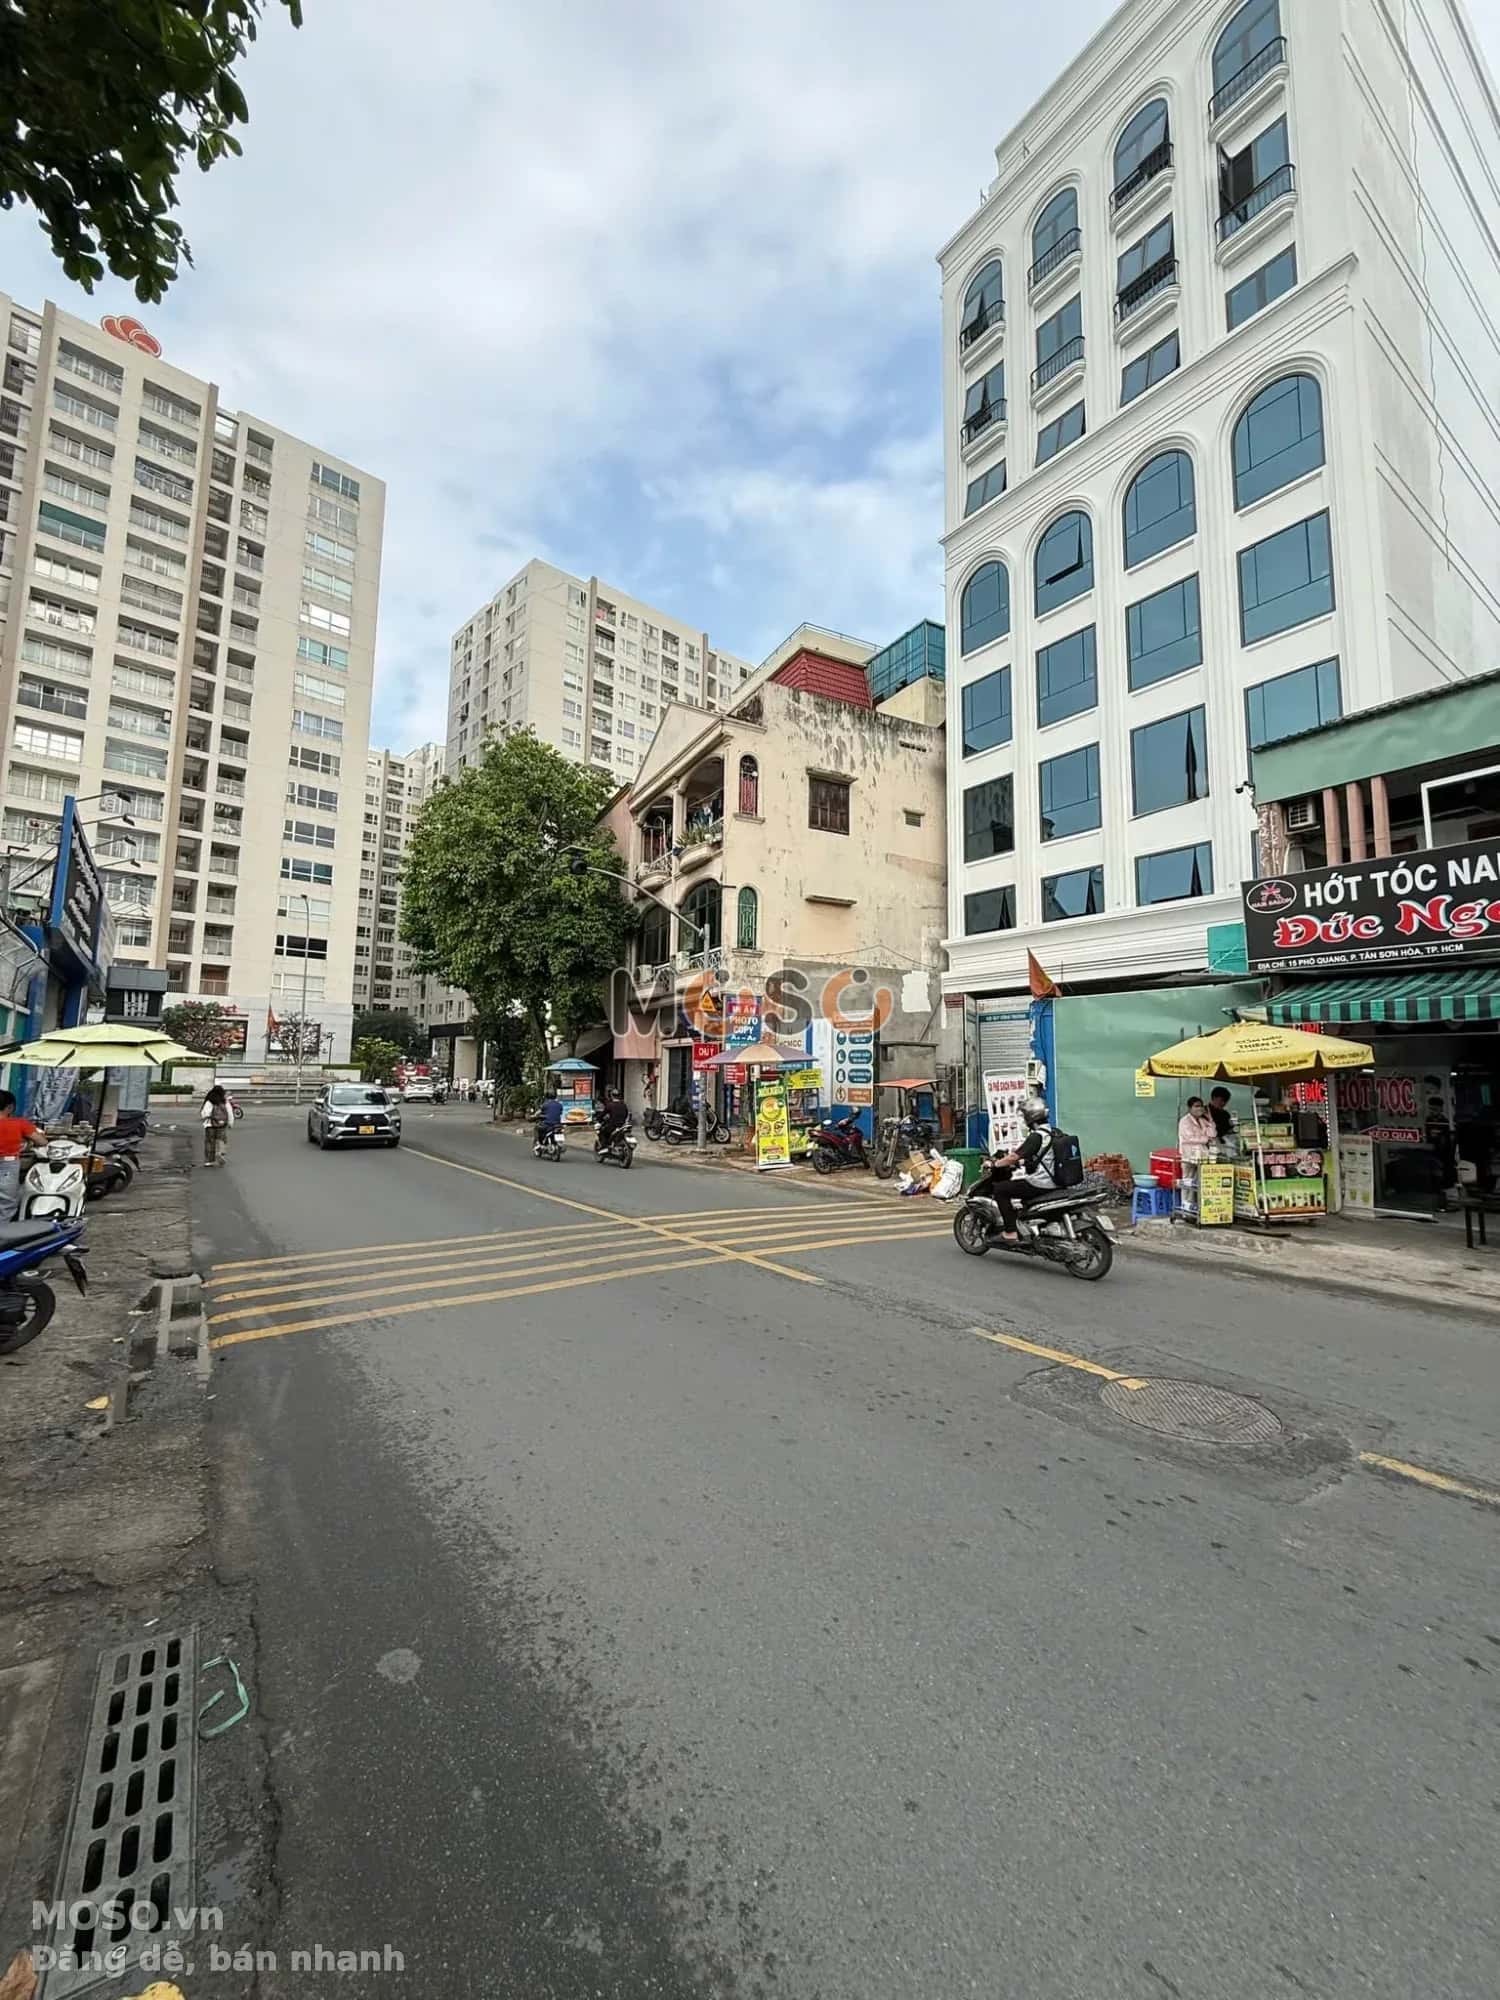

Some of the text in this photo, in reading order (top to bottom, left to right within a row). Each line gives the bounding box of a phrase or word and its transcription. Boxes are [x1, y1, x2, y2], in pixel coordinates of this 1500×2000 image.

[1304, 852, 1500, 908] HỚT TÓC NA
[1273, 912, 1384, 948] Đức
[1288, 960, 1298, 968] 15
[1350, 953, 1358, 962] P.
[1359, 951, 1378, 961] TÂN
[1379, 949, 1399, 959] SƠN
[1426, 945, 1439, 955] TP.
[1441, 943, 1464, 953] HCM
[729, 1015, 759, 1026] PHOTO
[733, 1025, 754, 1035] COPY
